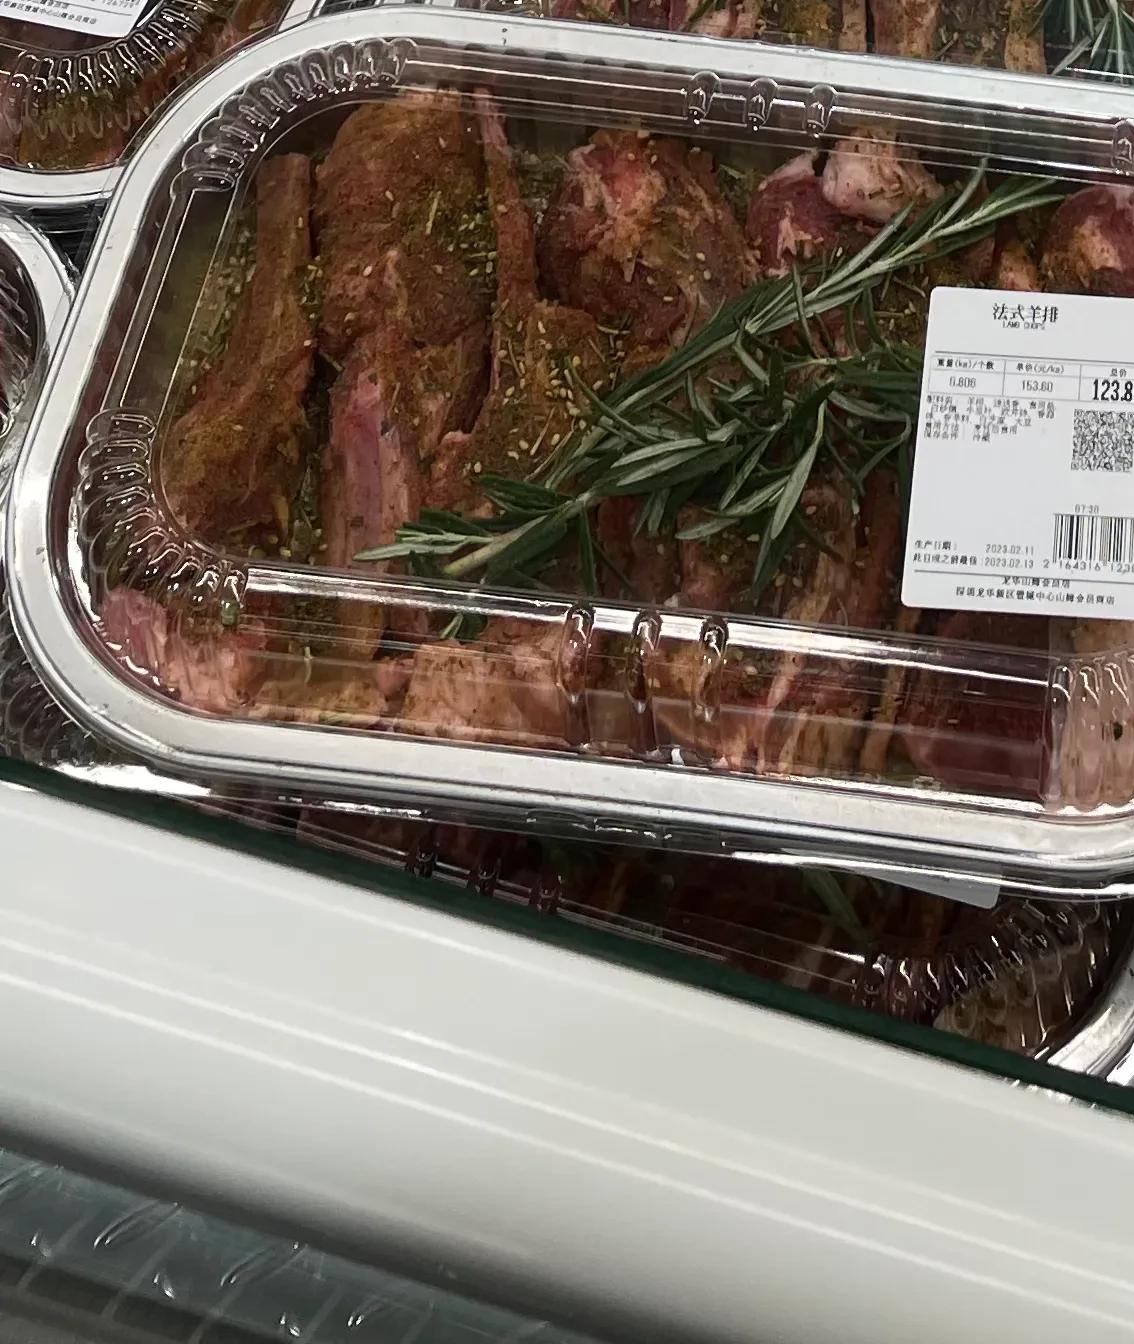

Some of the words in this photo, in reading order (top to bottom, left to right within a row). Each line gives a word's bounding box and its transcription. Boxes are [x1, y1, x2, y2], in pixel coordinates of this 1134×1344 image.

[992, 302, 1059, 324] 法式羊排
[1021, 379, 1054, 393] 153.60
[986, 543, 1034, 556] 2023.02.11
[984, 556, 1034, 569] 2023.02.13
[1043, 558, 1050, 569] 2
[1059, 559, 1101, 572] 164316
